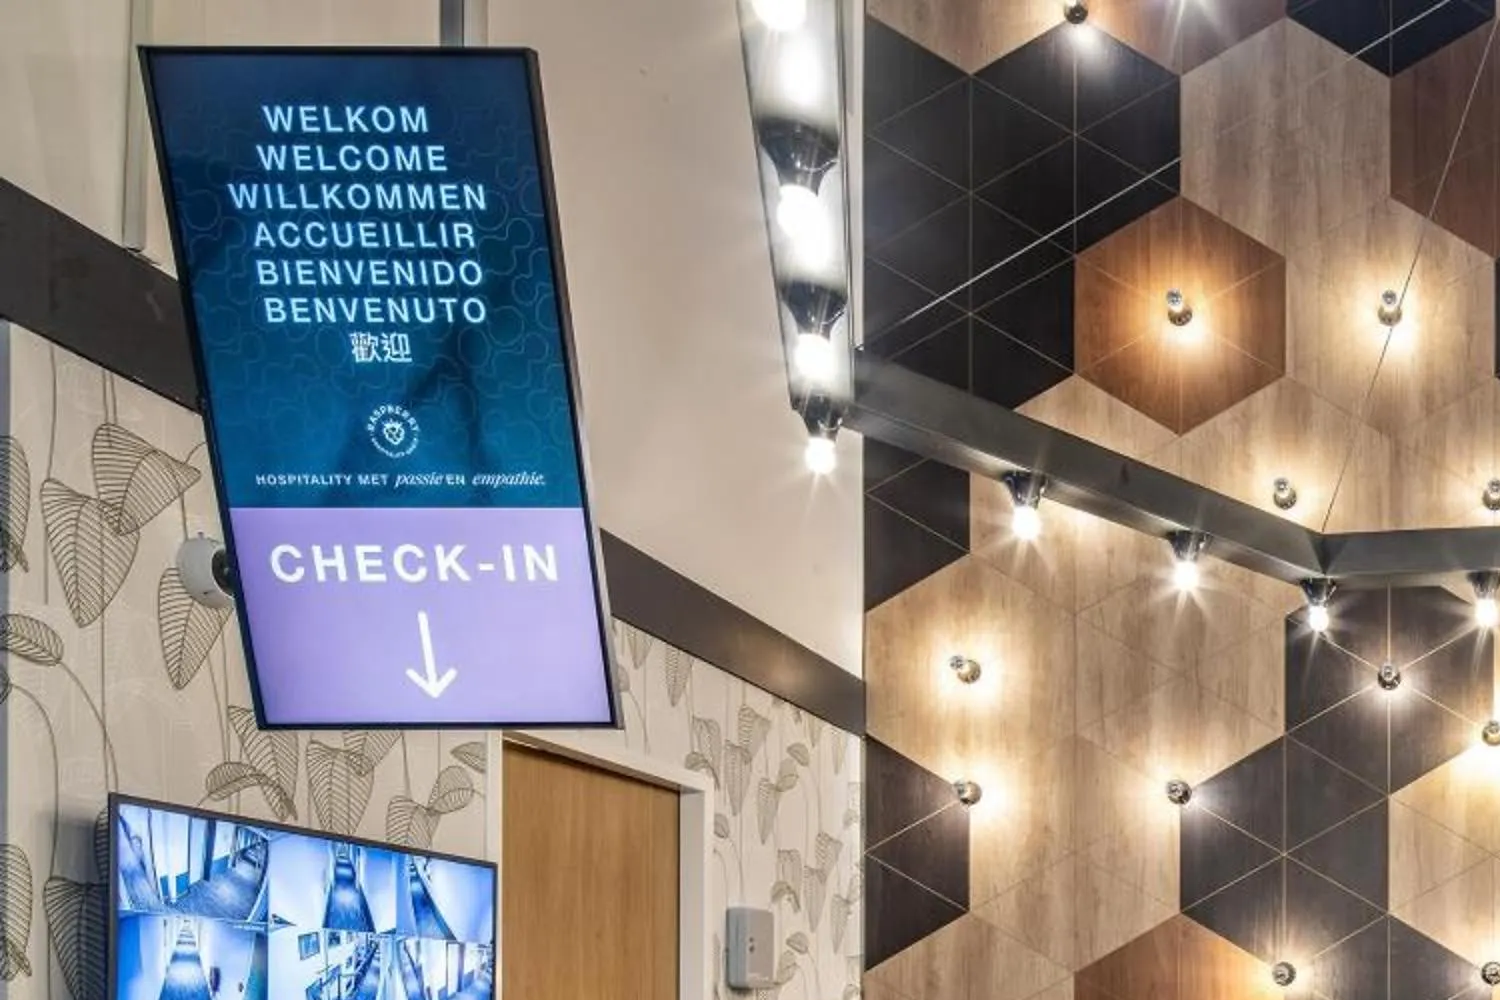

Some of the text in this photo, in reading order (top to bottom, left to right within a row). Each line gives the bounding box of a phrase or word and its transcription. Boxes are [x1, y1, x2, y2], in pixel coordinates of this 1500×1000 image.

[263, 106, 428, 133] WELKOM
[256, 145, 447, 171] WELCOME
[228, 183, 486, 210] WILLKOMMEN
[254, 221, 476, 248] ACCUEILLIR
[257, 260, 482, 286] BIENVENIDO
[264, 297, 487, 323] BENVENUTO
[350, 332, 412, 363] 歡迎
[255, 473, 351, 485] HOSPITALITY
[358, 474, 388, 485] MET
[446, 474, 465, 485] EN
[270, 543, 560, 584] CHECK-IN
